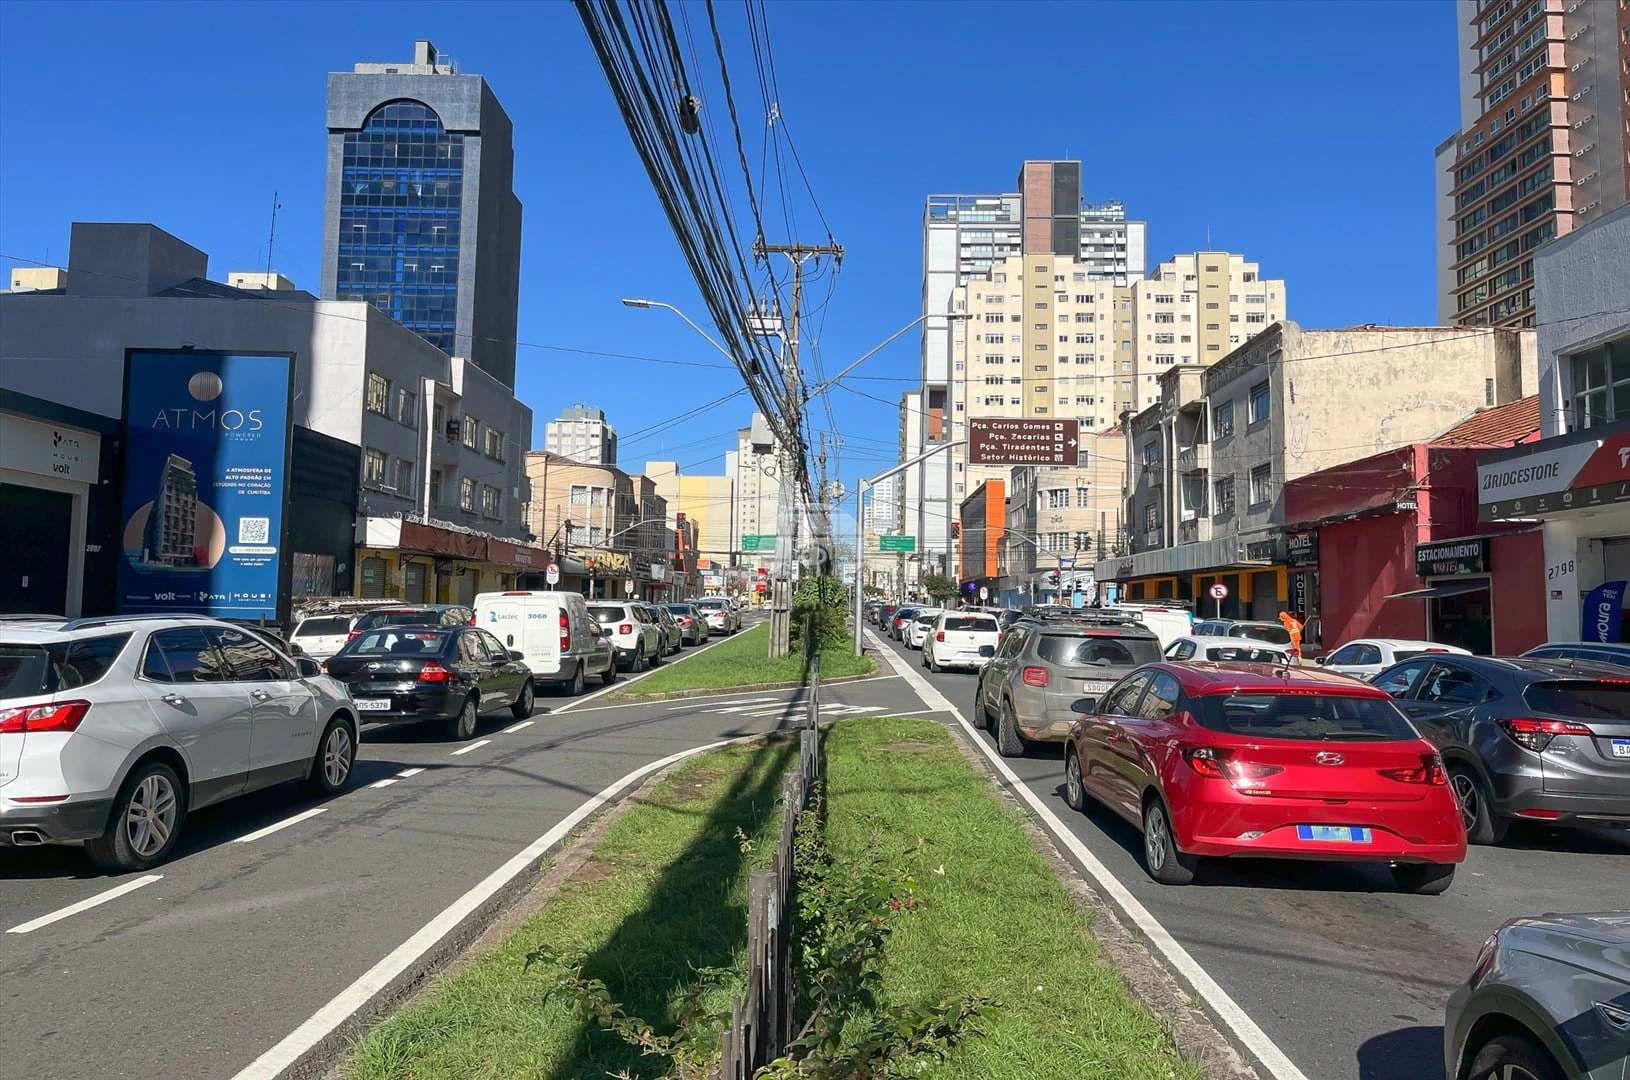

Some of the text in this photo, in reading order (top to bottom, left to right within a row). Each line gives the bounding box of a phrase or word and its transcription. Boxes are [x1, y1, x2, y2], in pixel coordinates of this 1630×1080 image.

[152, 408, 262, 431] ATMOS
[53, 464, 70, 474] volt
[1483, 462, 1560, 490] BRIDGESTONE
[1289, 536, 1312, 549] HOTEL
[1418, 544, 1479, 562] ESTACIONAMENTO
[1548, 560, 1574, 580] 2798
[154, 592, 175, 600] volt
